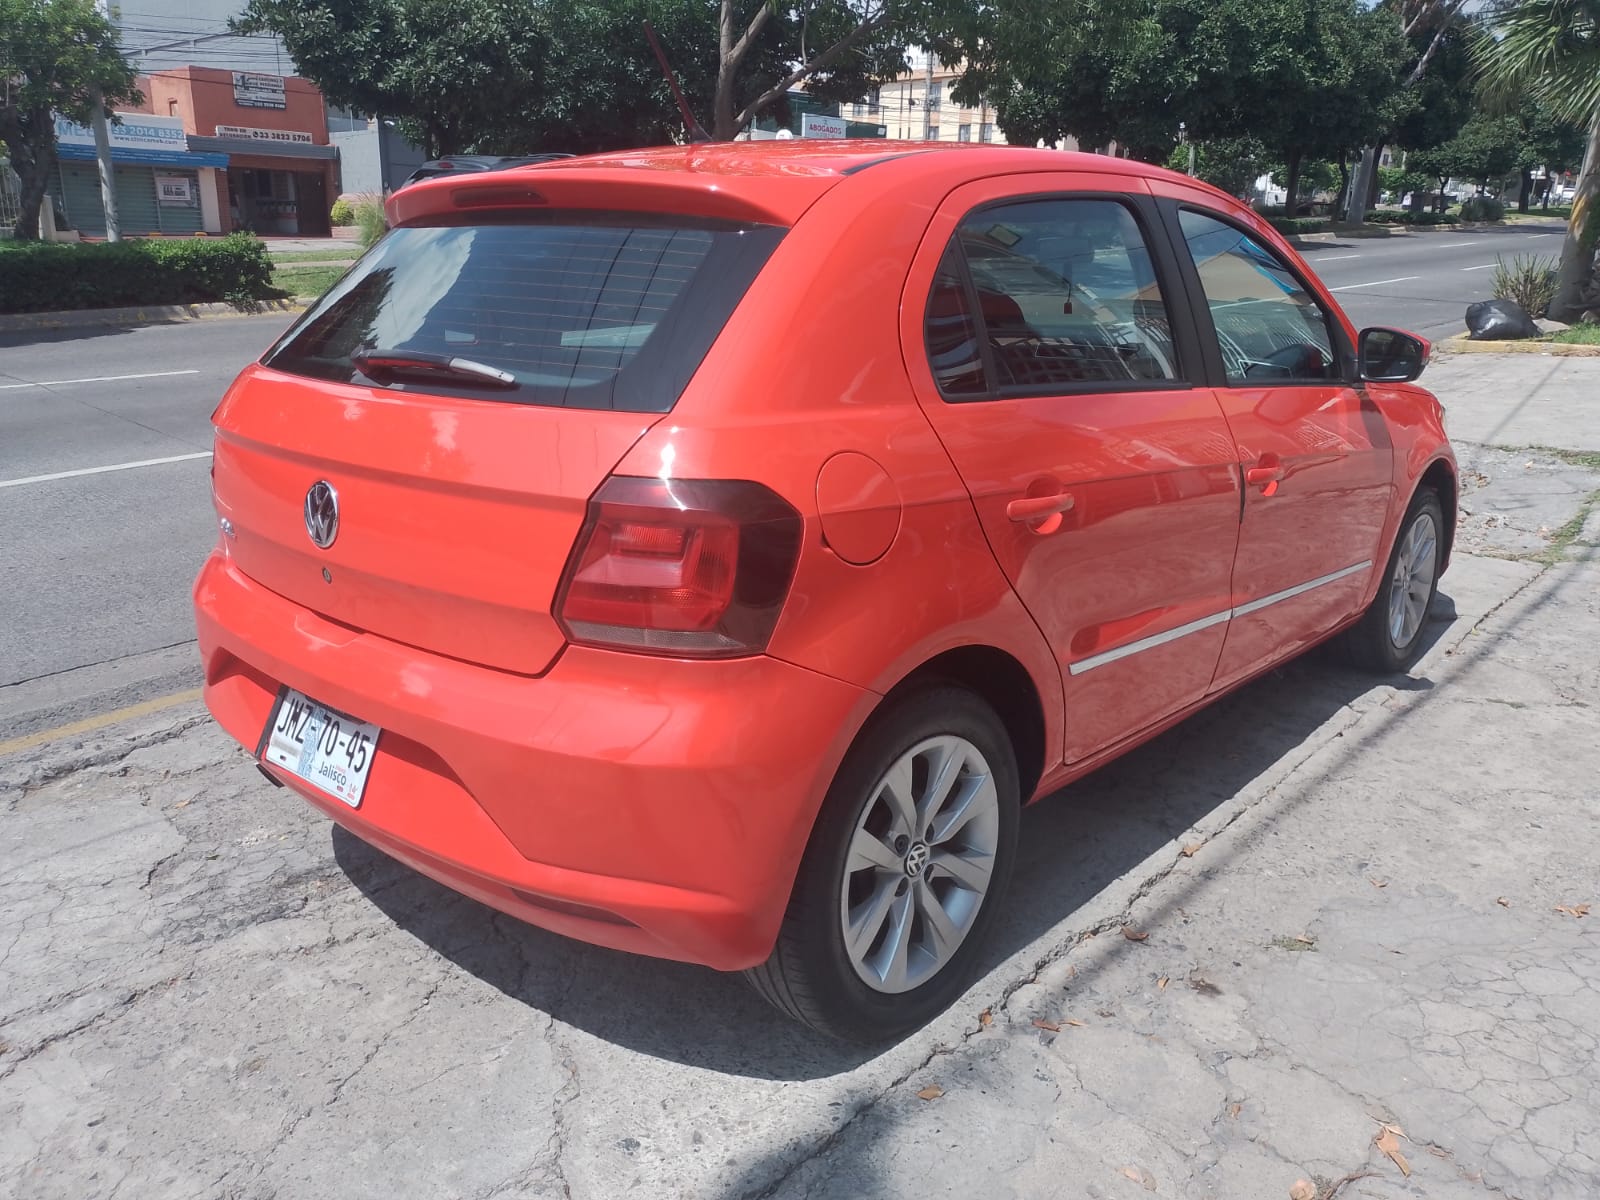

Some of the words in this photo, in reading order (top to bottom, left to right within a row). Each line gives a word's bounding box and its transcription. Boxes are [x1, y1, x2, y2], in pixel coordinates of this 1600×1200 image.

[130, 126, 155, 136] 2014
[158, 128, 183, 139] 8352
[809, 123, 842, 135] ABOGADOS
[292, 134, 311, 142] 5706
[277, 698, 371, 773] JMZ-70-45
[318, 761, 347, 786] Jalisco
